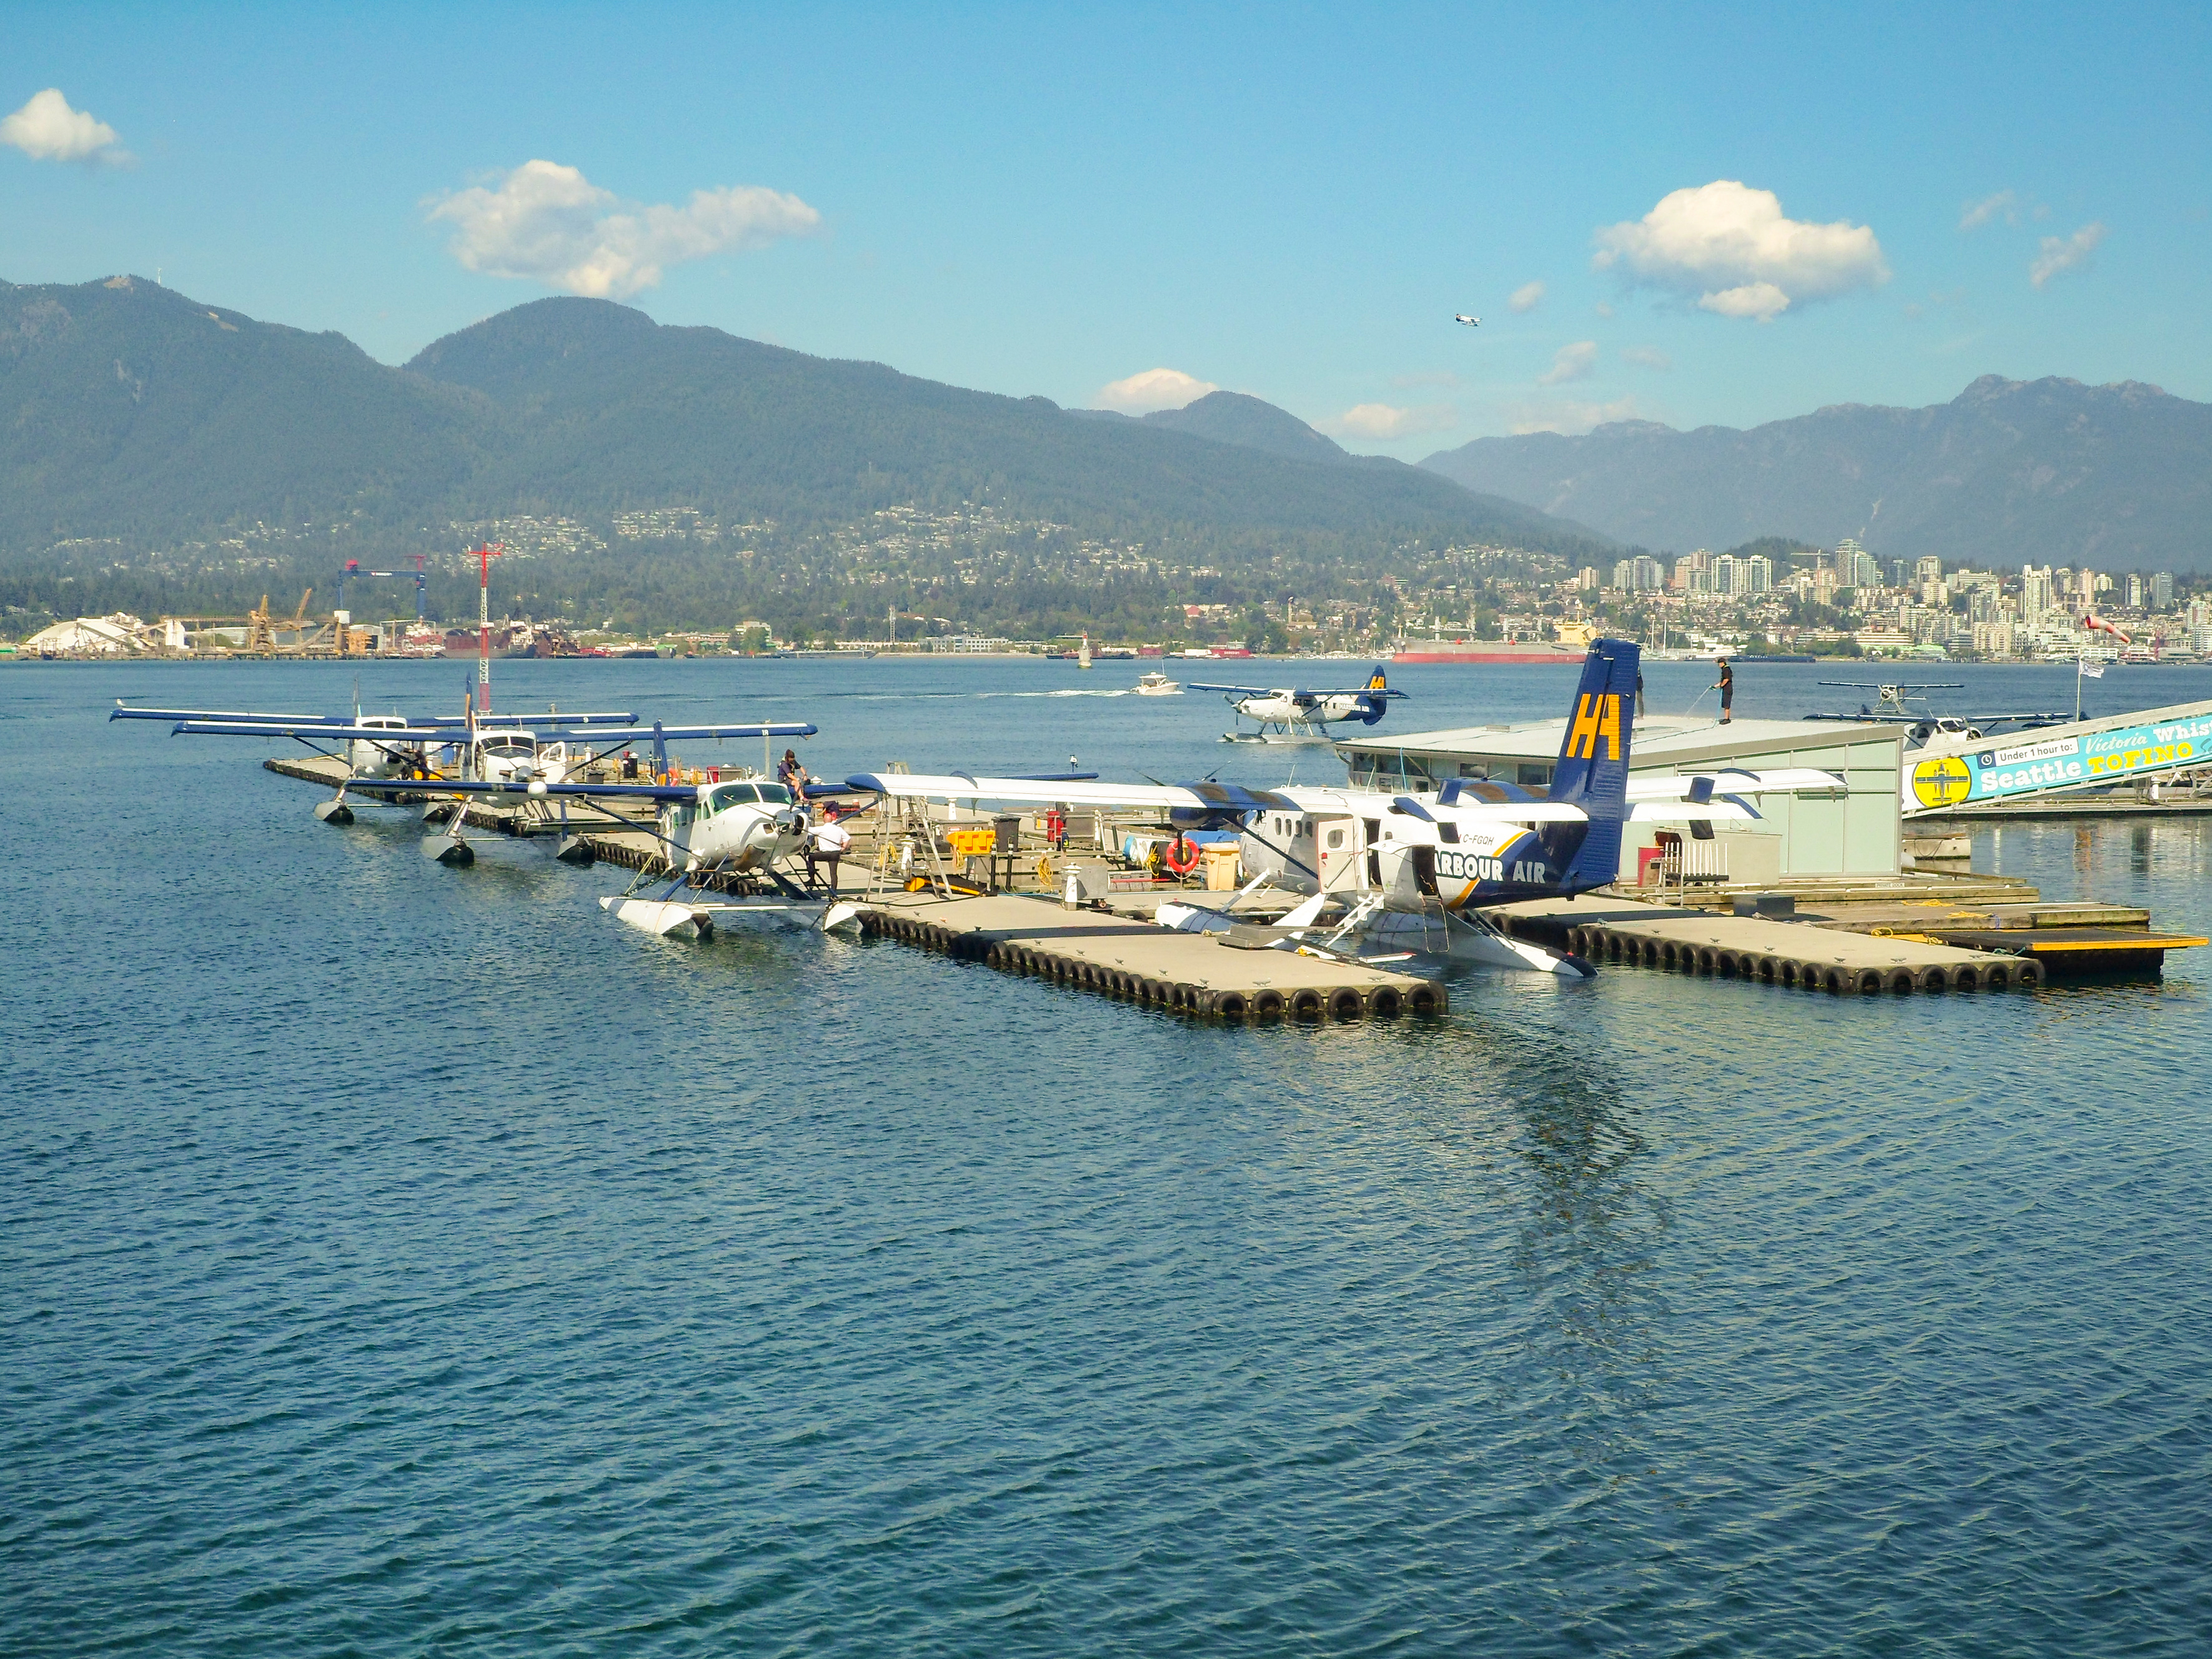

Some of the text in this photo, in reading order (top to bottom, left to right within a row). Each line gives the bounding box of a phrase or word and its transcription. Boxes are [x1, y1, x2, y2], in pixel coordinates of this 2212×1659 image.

[1339, 703, 1361, 711] HARBOUR
[1566, 693, 1620, 760] HA
[2000, 751, 2028, 761] Under
[2037, 747, 2058, 756] hour
[2061, 744, 2073, 752] to:
[2085, 733, 2148, 754] Victoria
[1980, 760, 2081, 793] Seattle
[2088, 741, 2193, 774] TOFINO
[1463, 834, 1495, 846] C-FGQH
[1513, 860, 1545, 884] AIR
